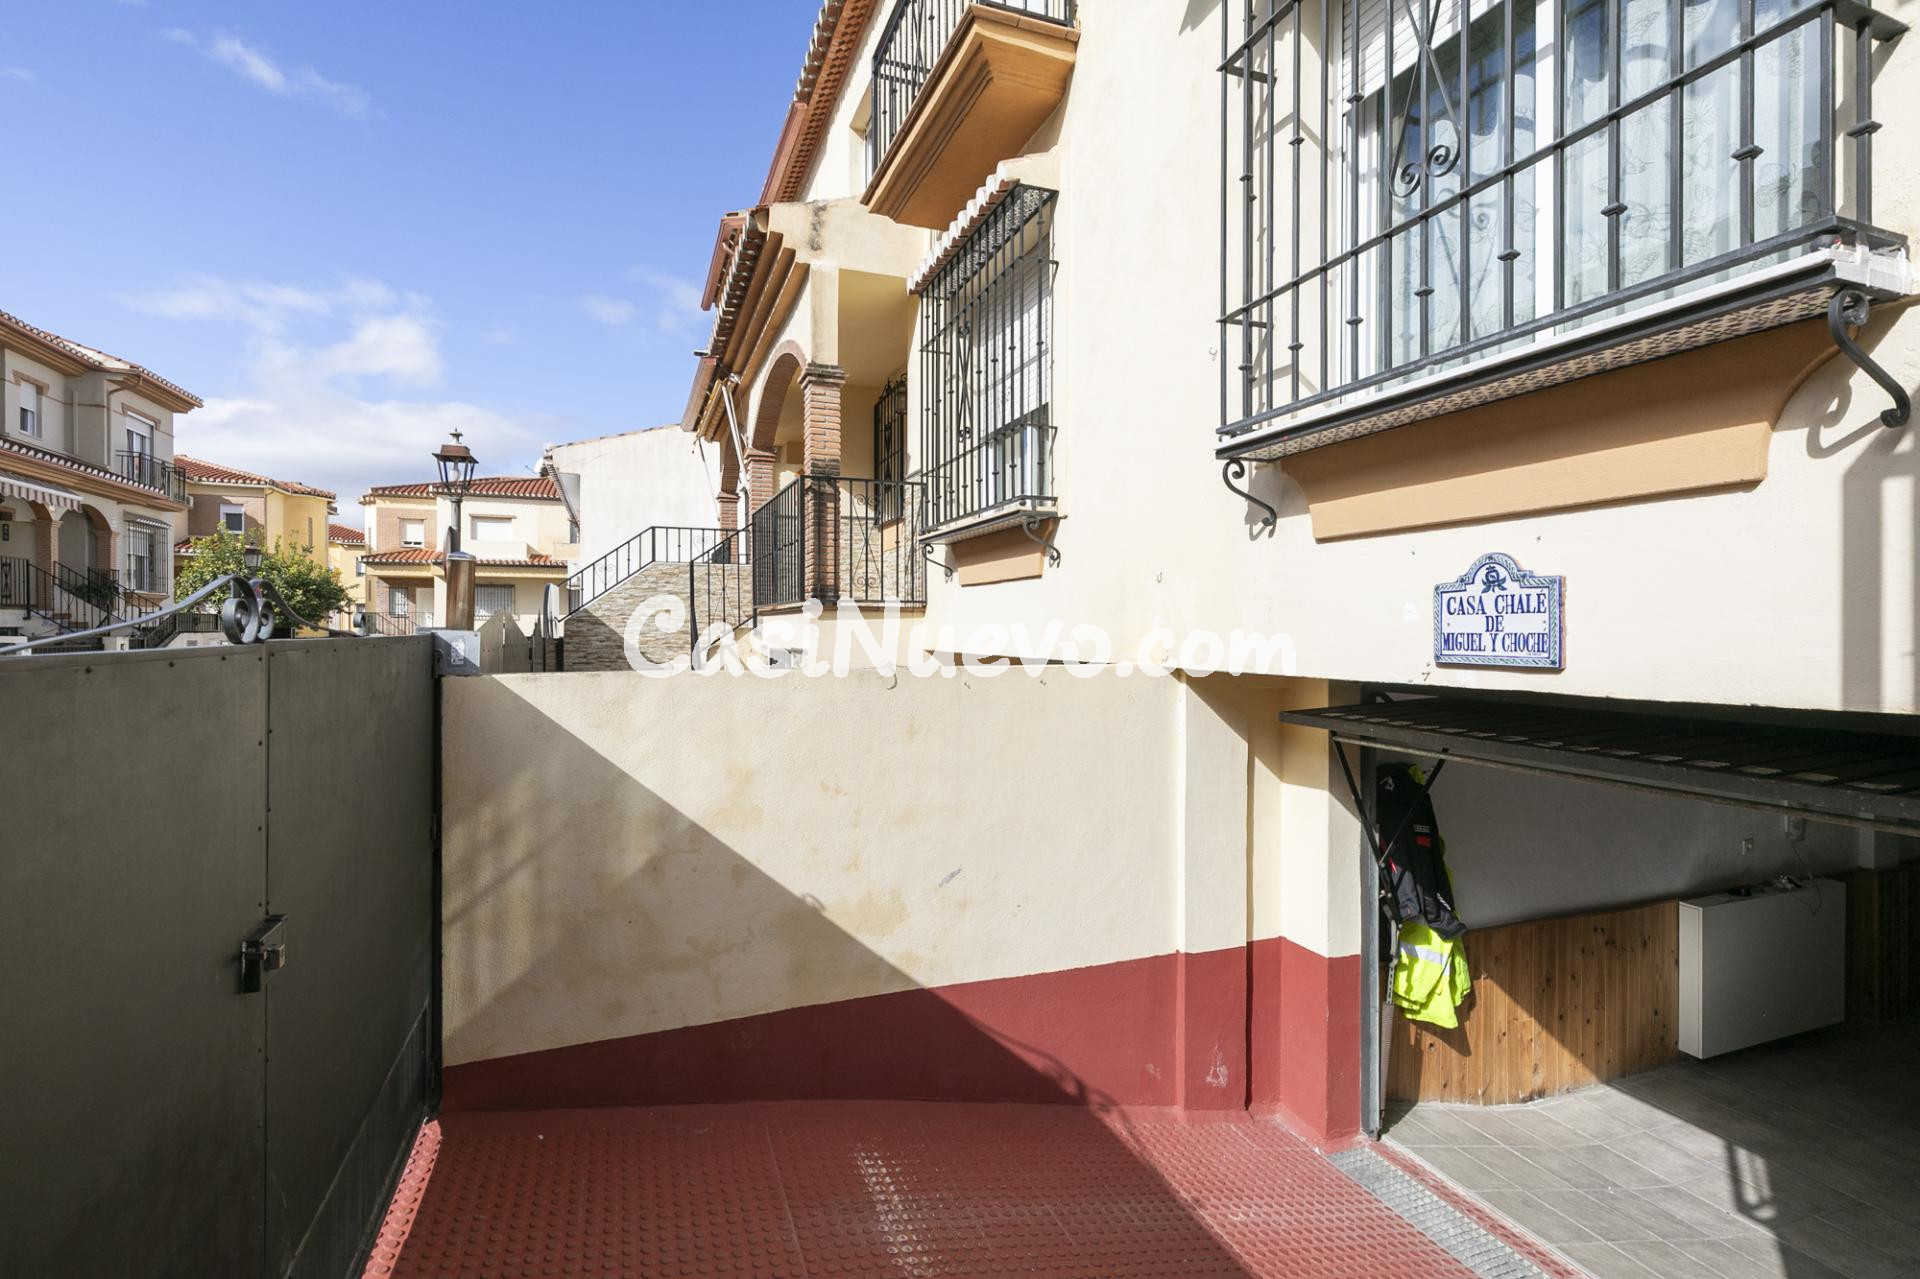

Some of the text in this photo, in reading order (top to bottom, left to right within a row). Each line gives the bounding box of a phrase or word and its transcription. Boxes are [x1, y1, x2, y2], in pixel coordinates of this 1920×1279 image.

[1447, 595, 1487, 615] CASA
[1485, 615, 1504, 632] DE
[1443, 633, 1486, 652] MIGUEL
[1490, 633, 1498, 652] Y
